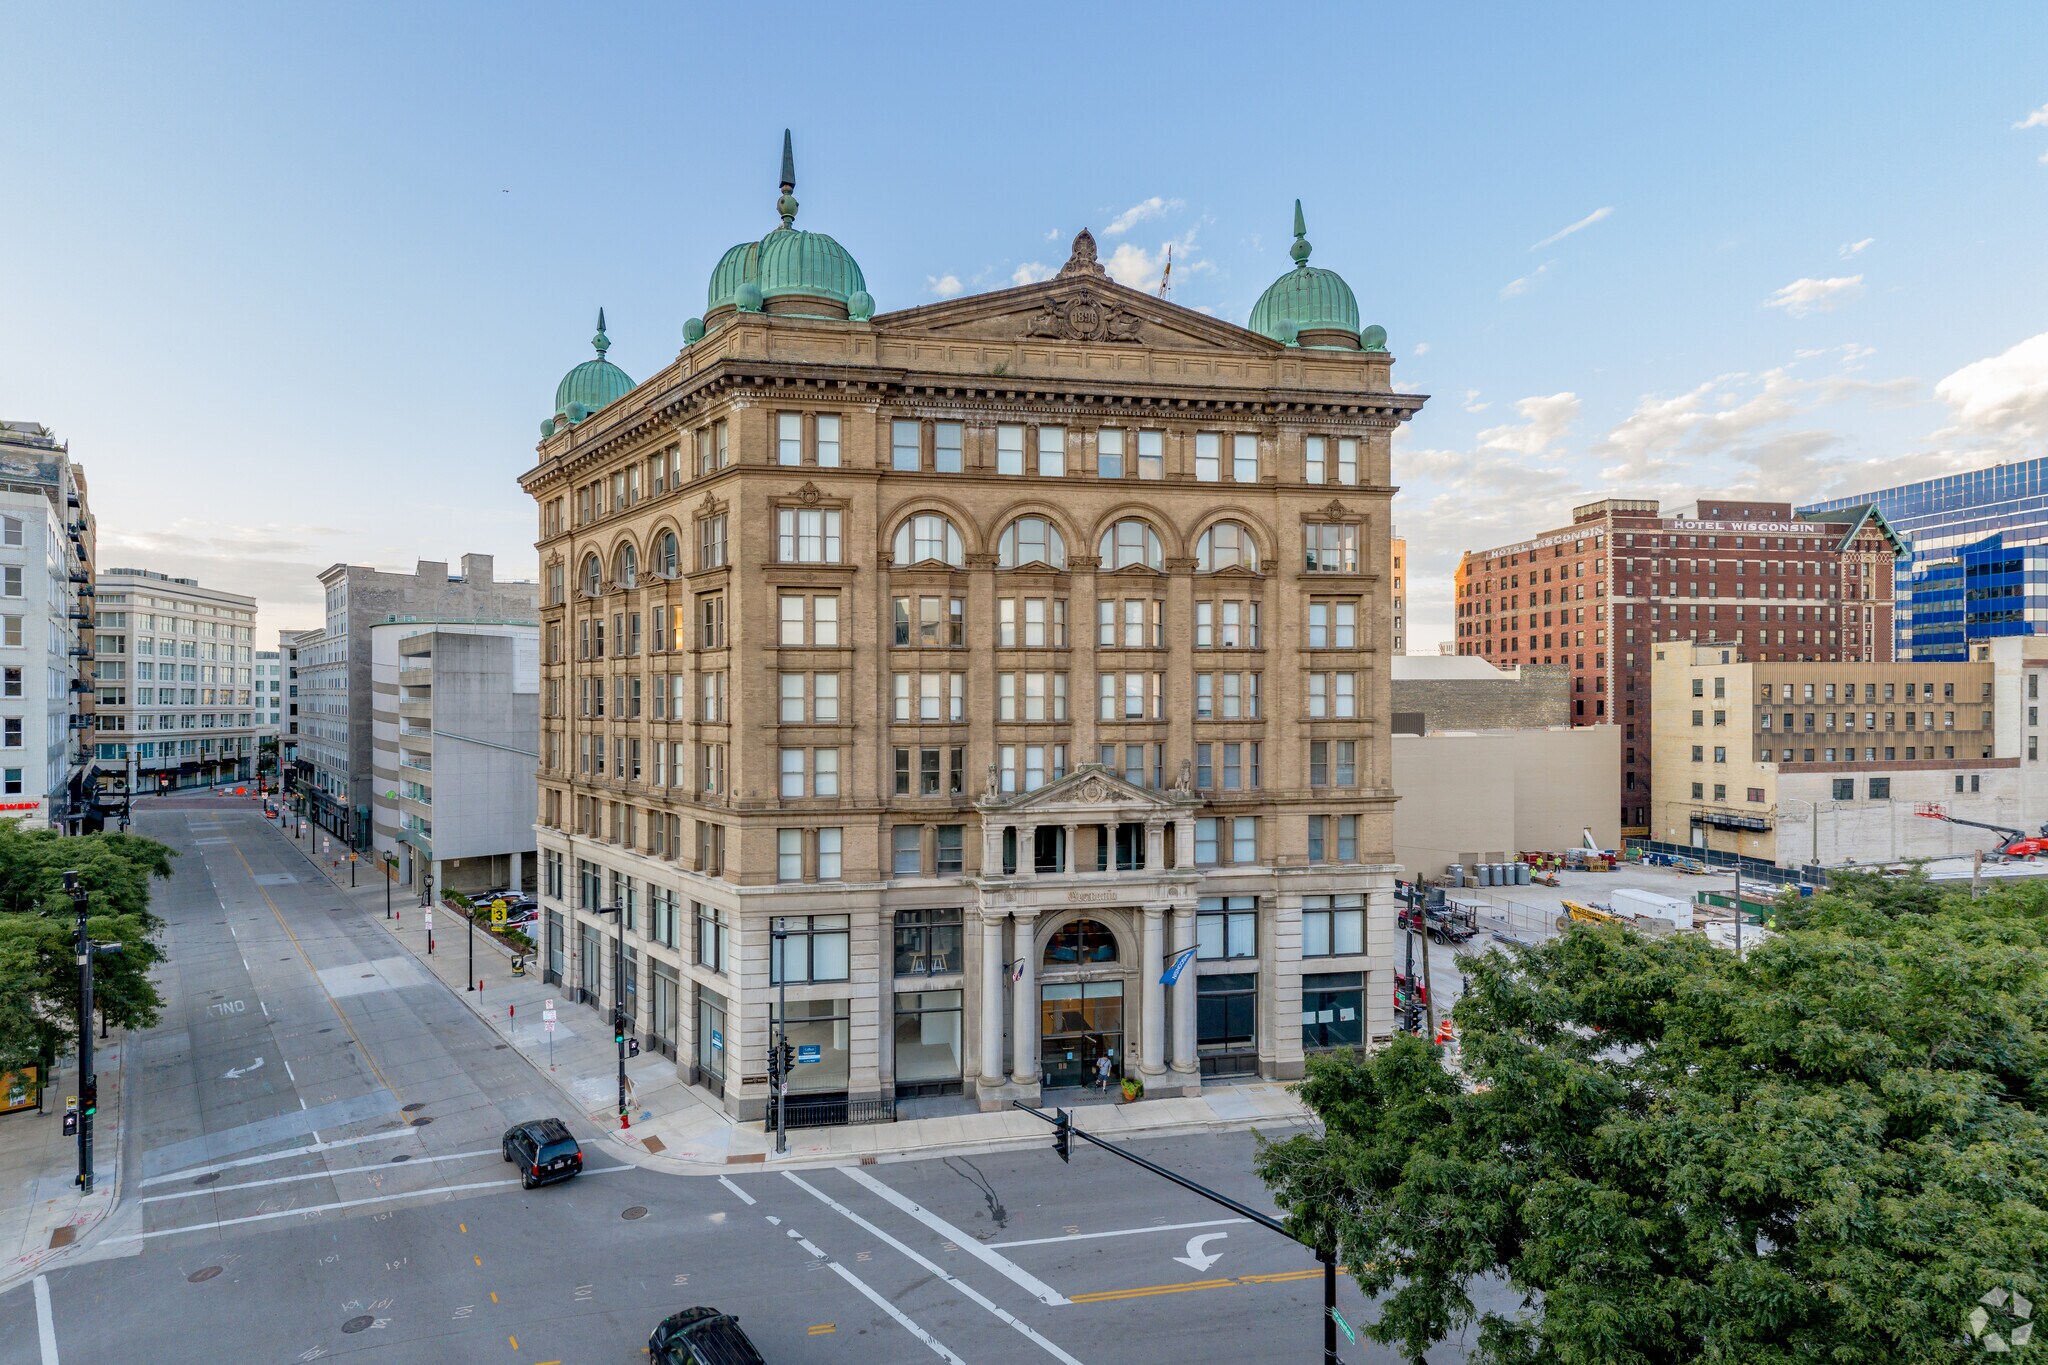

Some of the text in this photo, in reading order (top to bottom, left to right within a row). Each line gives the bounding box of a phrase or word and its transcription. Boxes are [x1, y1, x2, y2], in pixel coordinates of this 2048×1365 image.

[1073, 311, 1097, 324] 1896
[1674, 520, 1815, 532] HOTEL WISCONSIN
[1491, 525, 1604, 559] HOTEL WISCONSIN
[205, 1000, 245, 1019] ONLY
